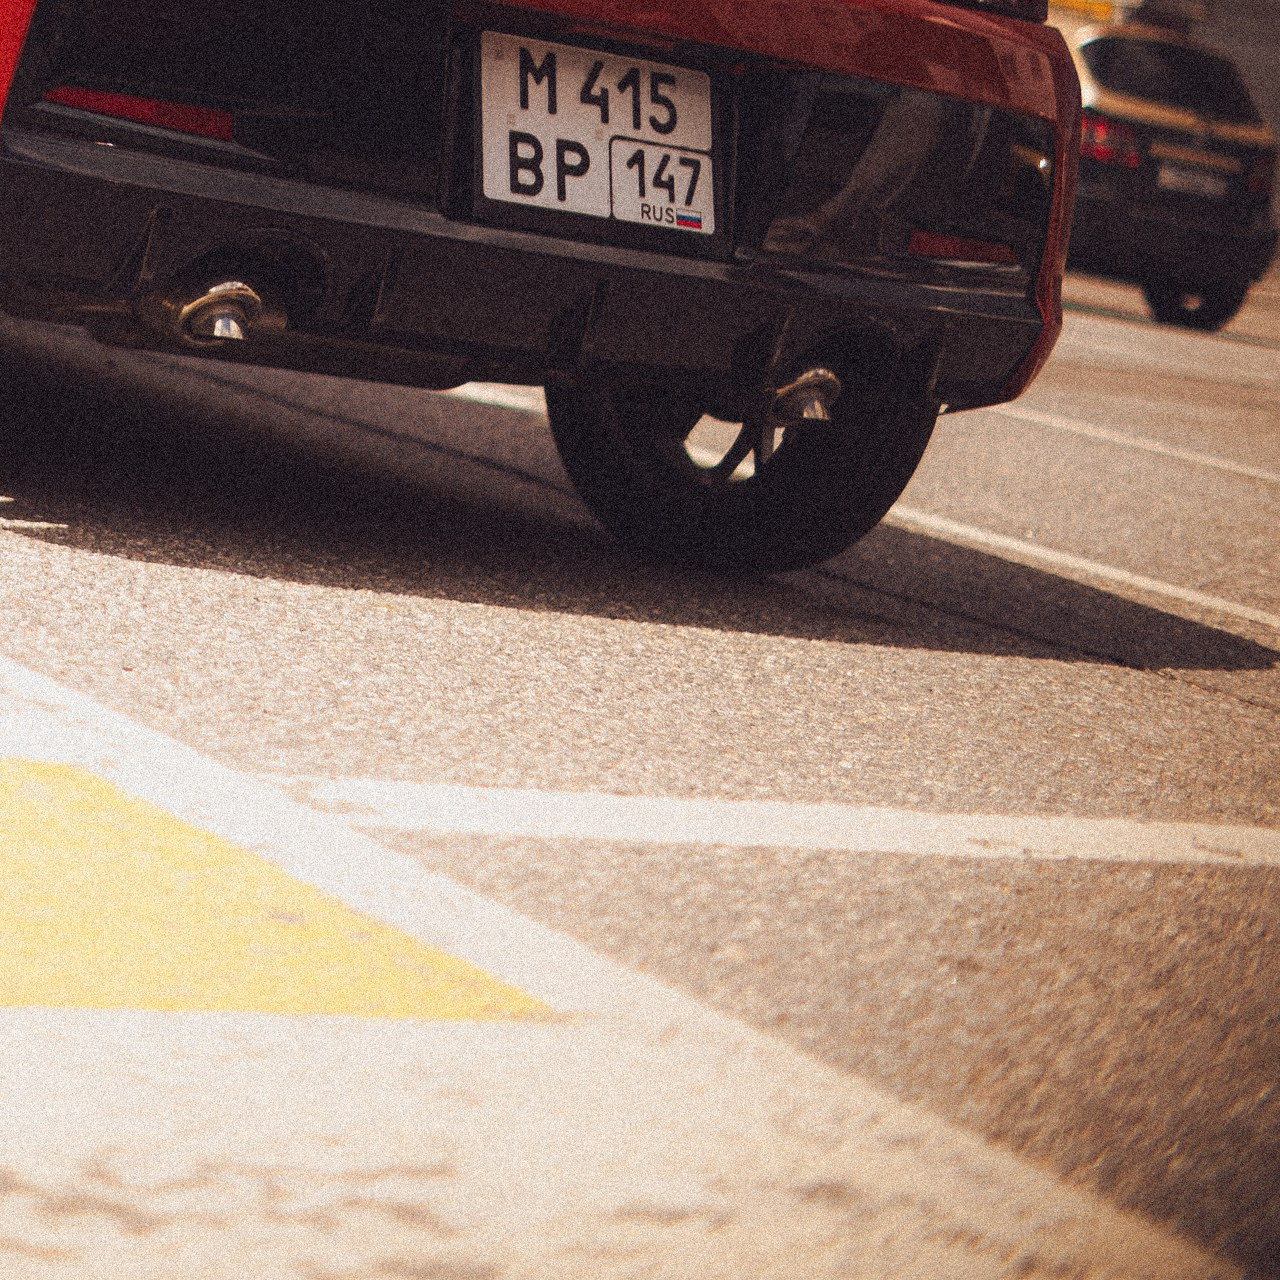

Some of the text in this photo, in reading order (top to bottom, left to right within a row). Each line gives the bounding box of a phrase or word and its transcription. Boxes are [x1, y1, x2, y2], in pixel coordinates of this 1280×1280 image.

[519, 46, 678, 135] M 415
[509, 129, 590, 202] BP
[626, 149, 701, 207] 147
[641, 203, 675, 224] RUS
